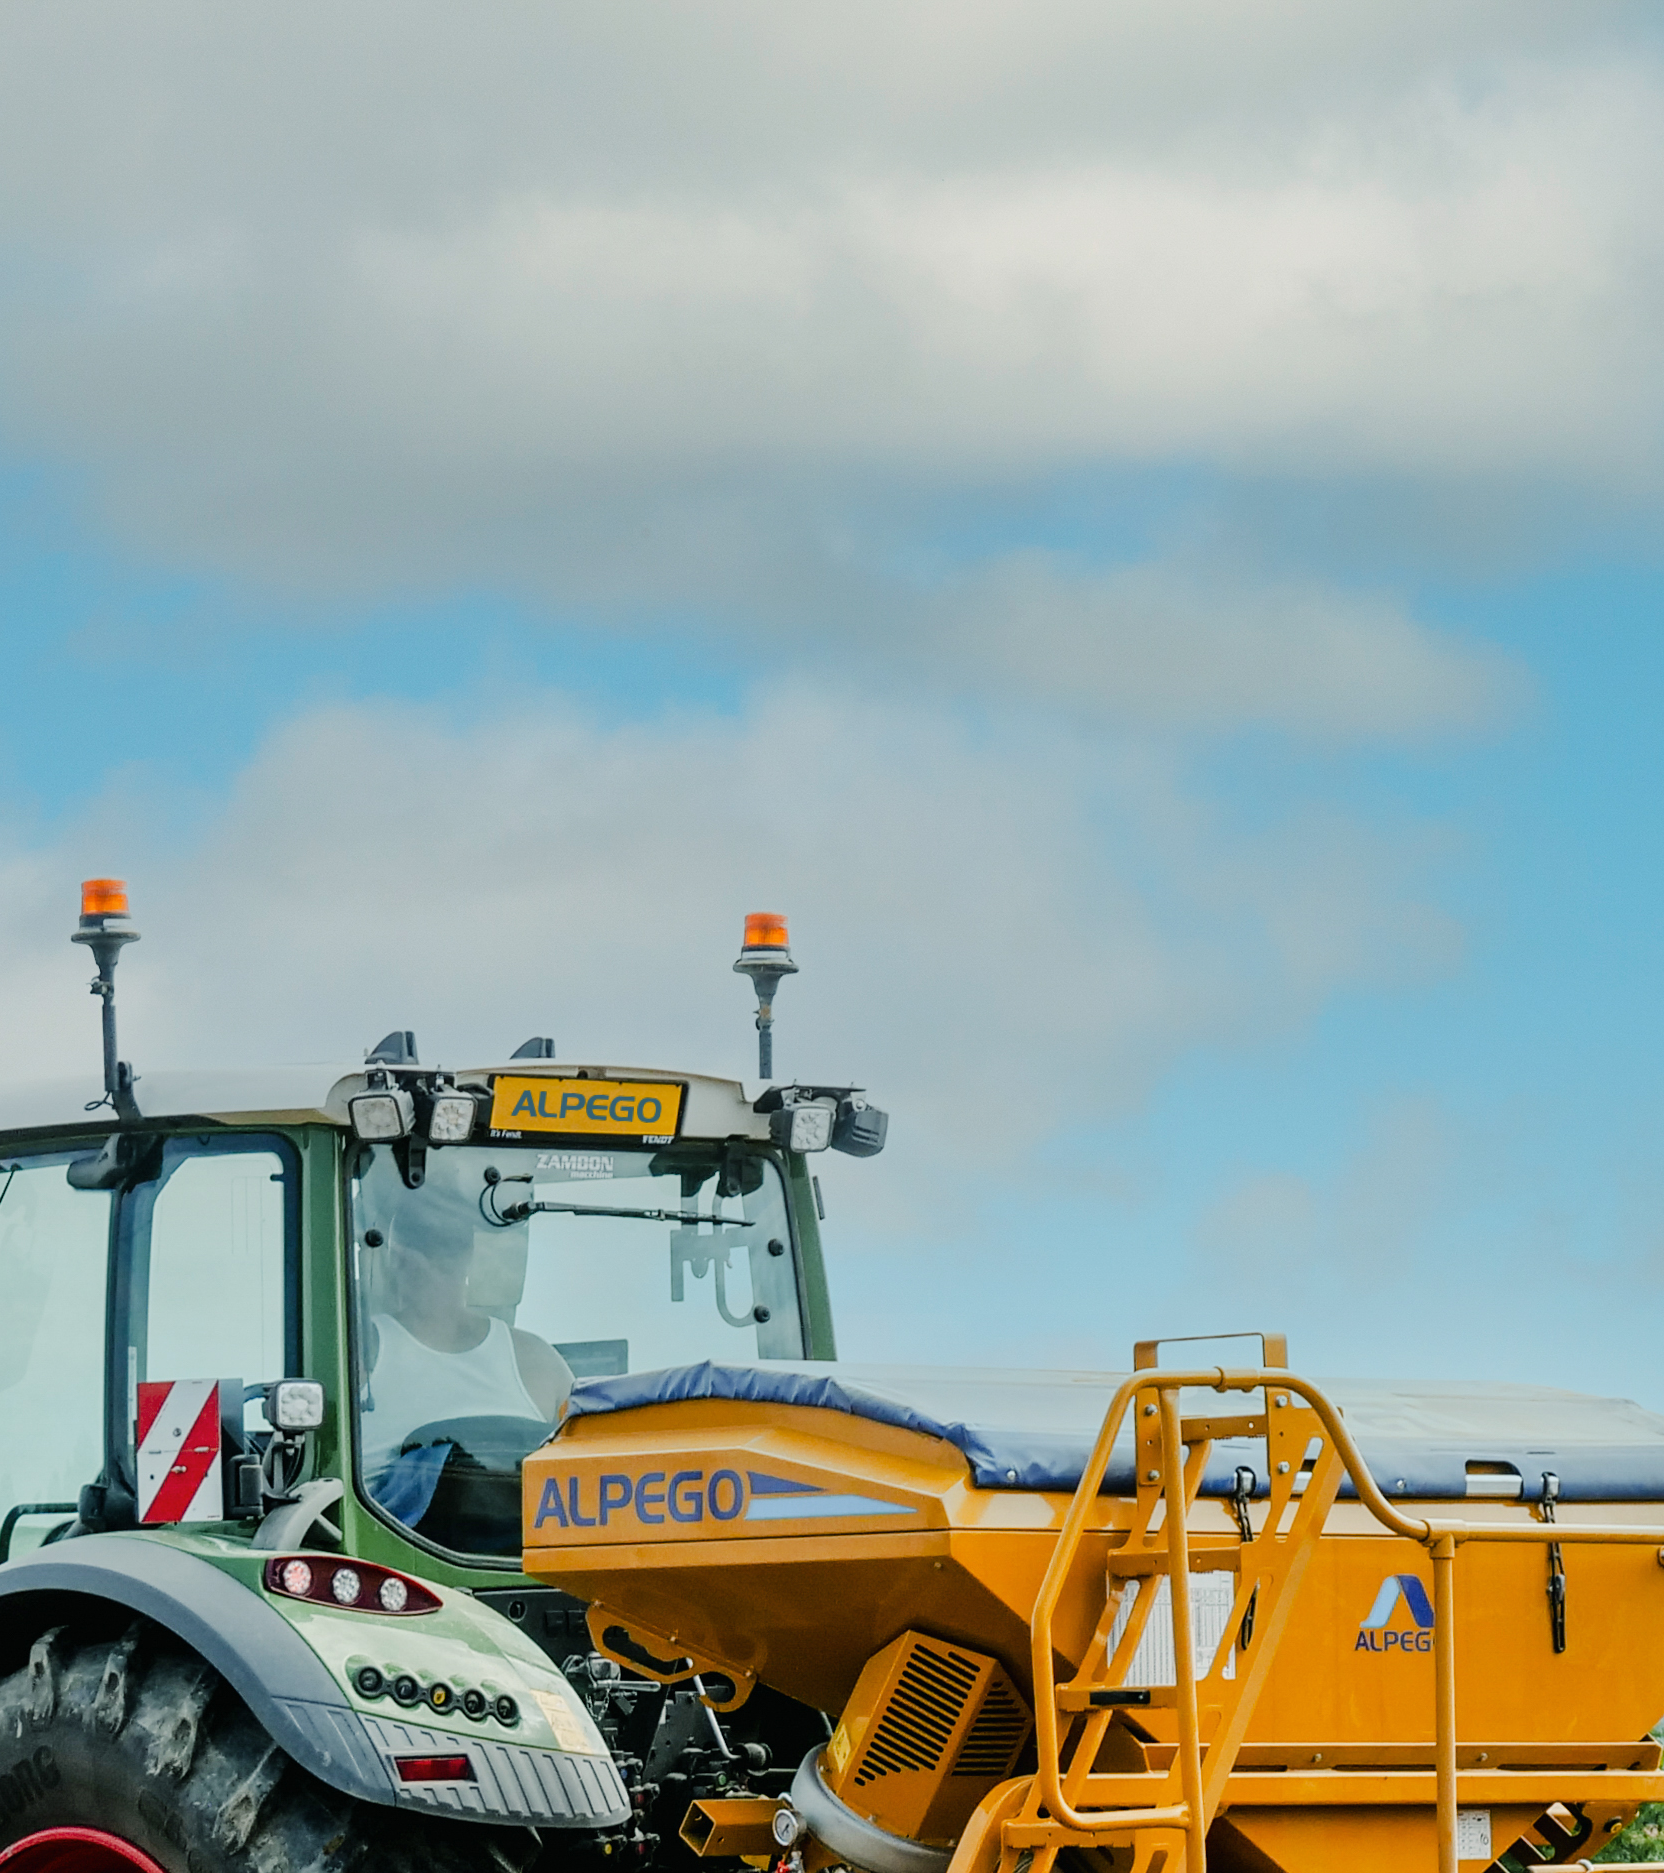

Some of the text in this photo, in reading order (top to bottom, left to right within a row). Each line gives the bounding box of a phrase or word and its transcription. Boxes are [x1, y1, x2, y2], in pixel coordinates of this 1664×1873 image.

[511, 1090, 662, 1124] ALPEGO
[534, 1469, 744, 1528] ALPEGO
[1354, 1630, 1435, 1652] ALPEG
